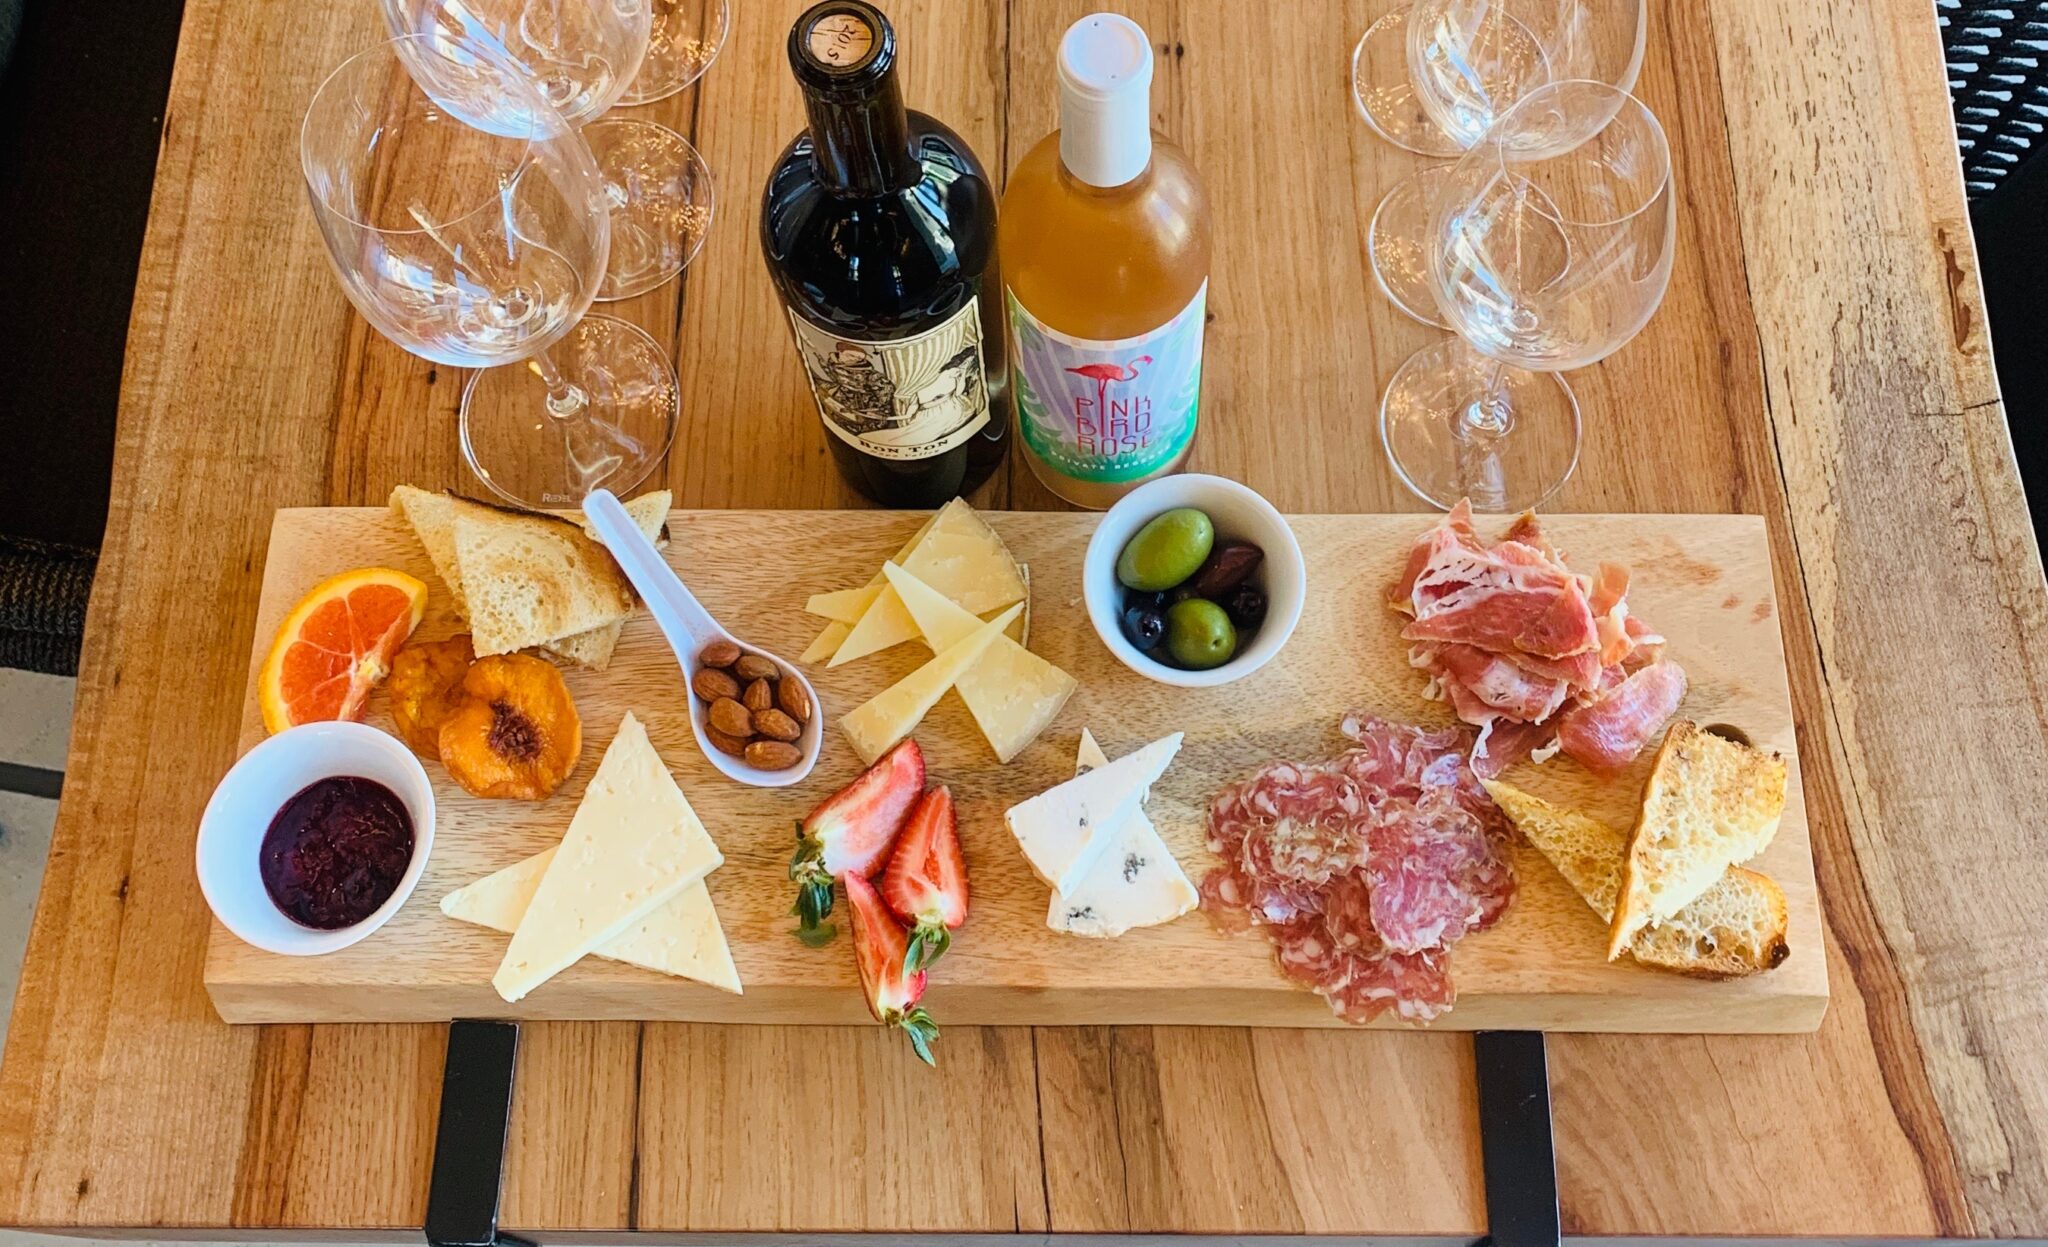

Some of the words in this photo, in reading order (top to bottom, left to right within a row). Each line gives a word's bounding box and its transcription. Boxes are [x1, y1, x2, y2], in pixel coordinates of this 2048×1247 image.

[827, 24, 857, 60] 2015
[1076, 395, 1151, 418] PINK
[1076, 412, 1151, 437] BIRD
[860, 440, 899, 453] BON
[908, 439, 948, 452] TON
